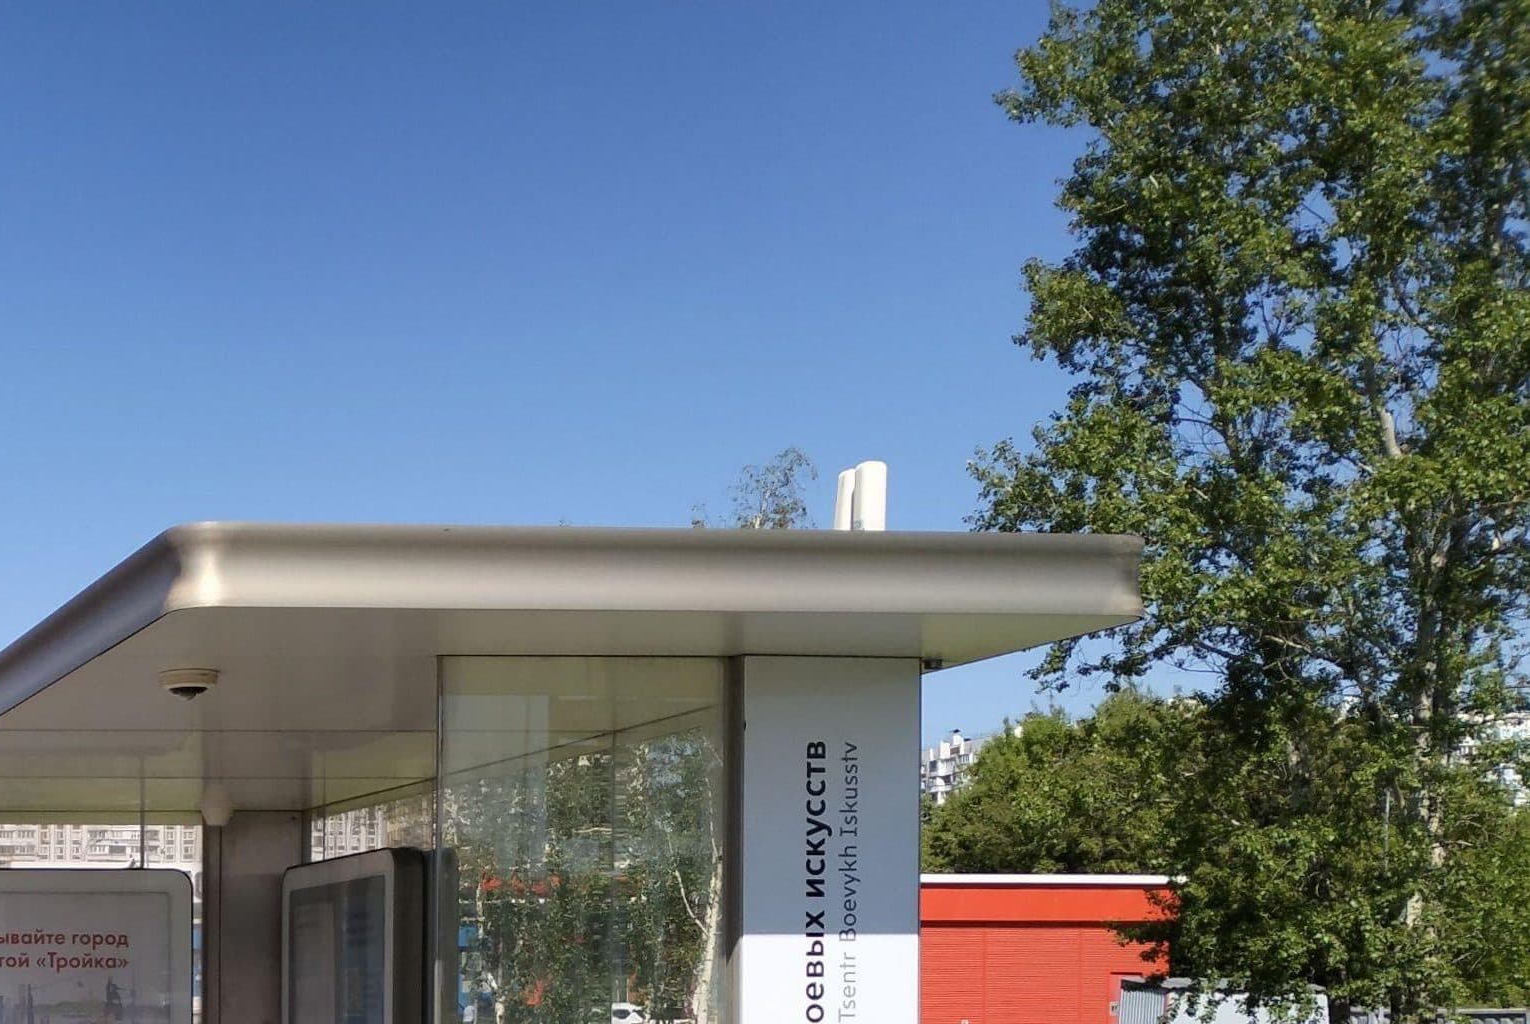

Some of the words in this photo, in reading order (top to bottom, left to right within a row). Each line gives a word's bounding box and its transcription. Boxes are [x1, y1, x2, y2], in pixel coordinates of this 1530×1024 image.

[806, 740, 833, 898] искусств
[840, 742, 859, 837] Iskusstv
[838, 845, 861, 942] Boevykh
[36, 951, 130, 973] «Тройка»
[72, 931, 129, 949] город
[838, 951, 857, 1023] Tsentr
